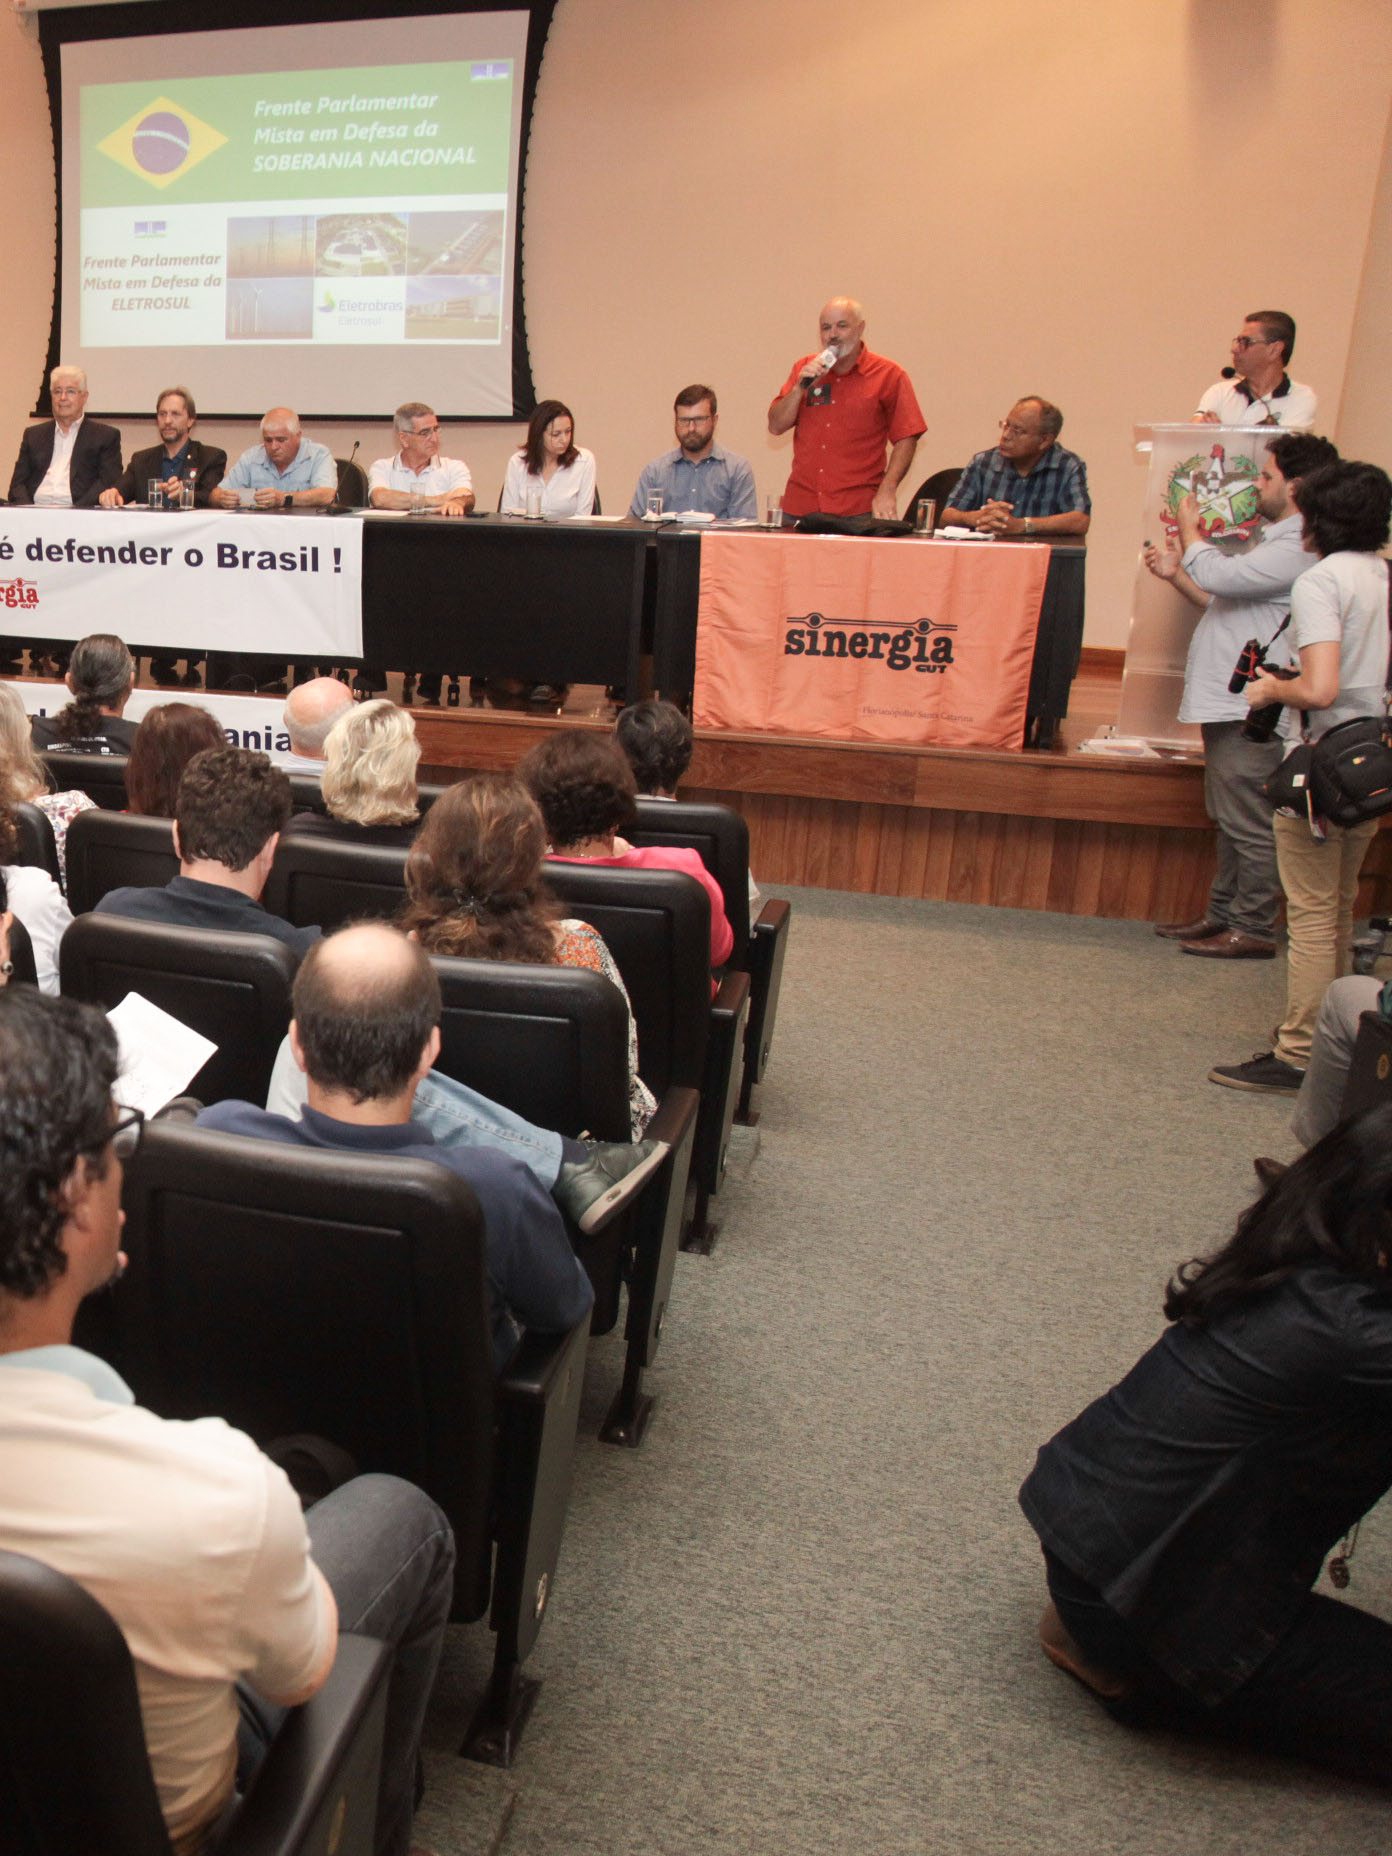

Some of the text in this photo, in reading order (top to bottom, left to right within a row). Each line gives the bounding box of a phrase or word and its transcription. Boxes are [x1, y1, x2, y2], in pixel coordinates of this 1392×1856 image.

[254, 93, 439, 117] Frente Parlamentar
[254, 119, 439, 144] Mista em Defesa da
[253, 146, 477, 172] SOBERANIA NACIONAL
[83, 253, 221, 269] Frente Parlamentar
[83, 273, 221, 291] Mista em Defesa da
[111, 296, 191, 311] ELETROSUL
[338, 299, 403, 312] Eletrobras
[26, 538, 173, 566] defender
[184, 548, 204, 567] o
[217, 543, 319, 573] Brasil
[785, 613, 954, 671] sinergia
[915, 664, 948, 674] CUT
